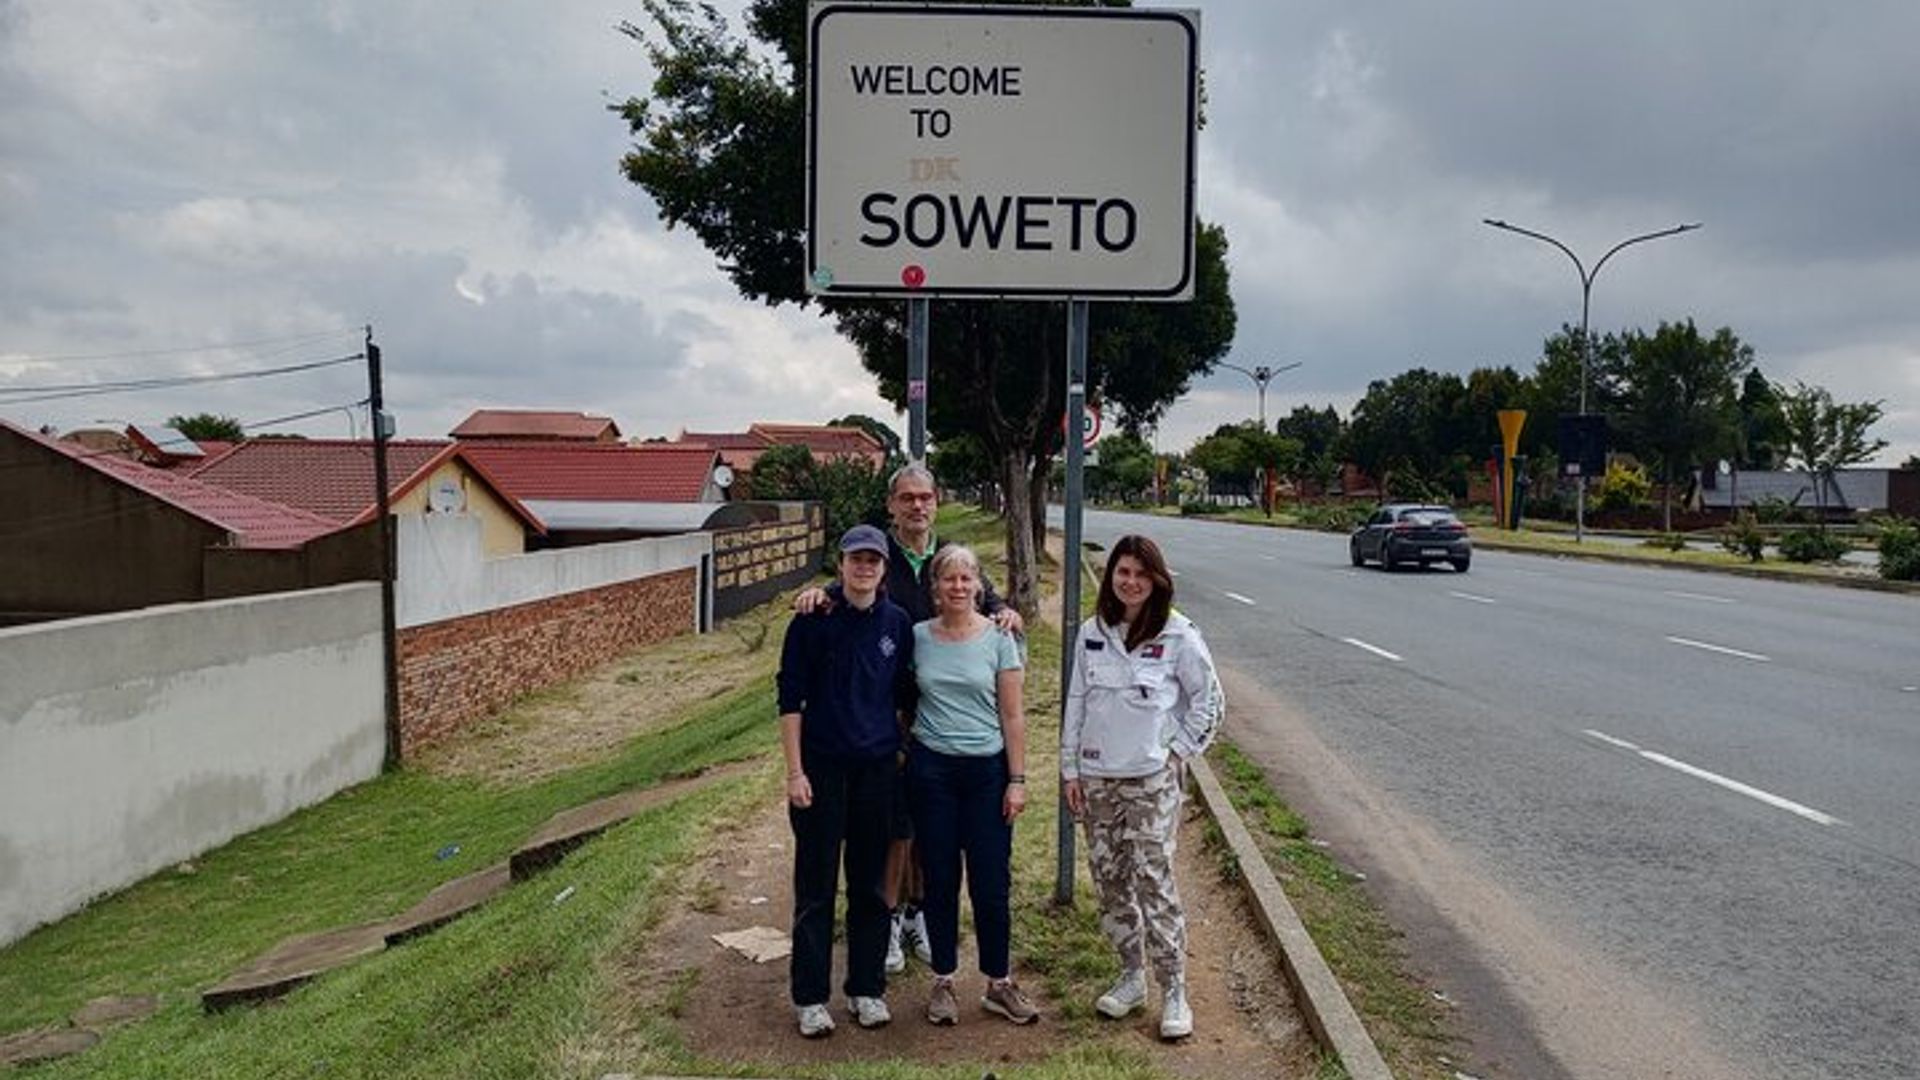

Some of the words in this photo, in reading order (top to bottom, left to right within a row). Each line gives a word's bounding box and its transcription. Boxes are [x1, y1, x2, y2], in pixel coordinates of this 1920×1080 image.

[851, 66, 1021, 95] WELCOME
[910, 109, 950, 138] TO
[910, 157, 960, 181] DK
[860, 193, 1136, 252] SOWETO
